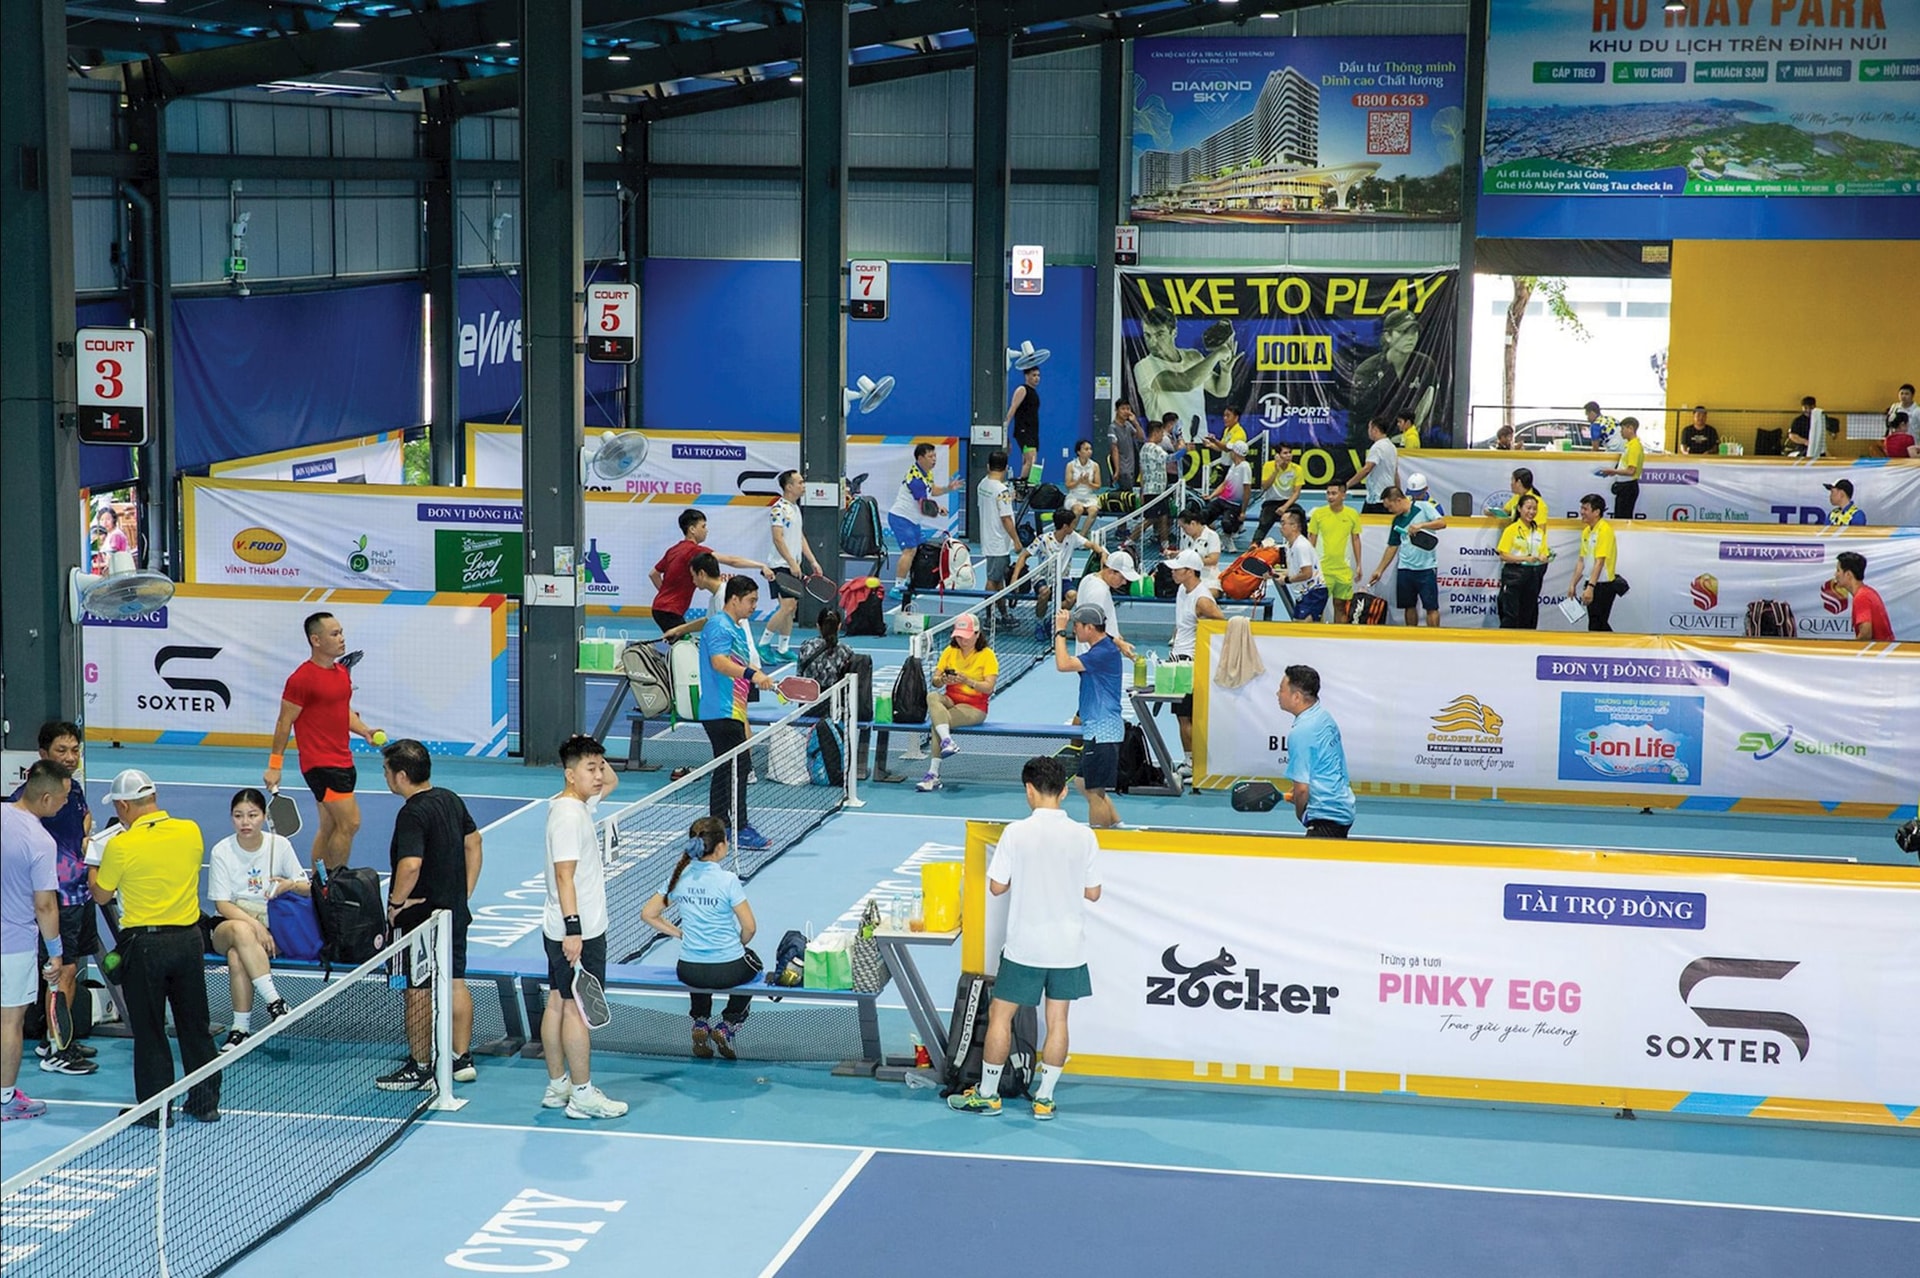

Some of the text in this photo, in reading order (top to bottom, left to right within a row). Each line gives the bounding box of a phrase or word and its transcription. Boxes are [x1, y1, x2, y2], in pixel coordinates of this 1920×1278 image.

[1590, 33, 1887, 55] KHU DU LỊCH TRÊN ĐỈNH NÚI
[1339, 60, 1457, 75] Đầu tư Thông minh
[1552, 66, 1596, 78] CÁP TREO
[1633, 67, 1673, 78] VUI CHƠI
[1711, 65, 1765, 80] KHÁCH SẠN
[1794, 65, 1843, 77] NHÀ HÀNG
[1883, 64, 1900, 78] HỘI
[1172, 81, 1252, 91] DIAMOND
[1353, 76, 1375, 86] cao
[1378, 74, 1406, 86] Chất
[1409, 74, 1444, 88] lượng
[1193, 92, 1229, 102] SKY
[1356, 94, 1424, 106] 1800 6363
[1496, 169, 1507, 178] Ai
[1509, 169, 1519, 178] đi
[1567, 169, 1582, 179] Sài
[1584, 170, 1609, 179] Gòn,
[1496, 181, 1516, 190] Ghé
[1557, 181, 1581, 190] Park
[1582, 181, 1609, 192] Vũng
[1610, 182, 1629, 190] Tàu
[1631, 181, 1661, 190] check
[1663, 182, 1673, 190] in
[1116, 236, 1135, 250] 11
[855, 264, 882, 272] COURT
[1020, 258, 1033, 275] 9
[859, 275, 875, 296] 7
[594, 290, 629, 300] COURT
[1137, 276, 1448, 315] LIKE TO PLAY
[600, 304, 620, 332] 5
[84, 340, 135, 352] COURT
[1260, 341, 1328, 366] JOOLA
[94, 359, 124, 399] 3
[1283, 406, 1331, 417] SPORTS
[676, 446, 742, 458] TÀI TRỢ ĐỒNG
[1646, 472, 1668, 482] TRỢ
[1669, 473, 1690, 483] BẠC
[625, 480, 670, 494] PINKY
[674, 482, 702, 494] EGG
[427, 508, 451, 518] ĐƠN
[454, 509, 466, 520] VỊ
[469, 507, 501, 519] ĐỒNG
[1460, 547, 1499, 556] DoanhN
[1727, 544, 1818, 559] TÀI TRỢ VÀNG
[463, 551, 495, 571] Live
[463, 554, 503, 583] cool
[282, 567, 300, 578] ĐẠT
[1450, 564, 1471, 575] GIẢI
[587, 585, 619, 593] GROUP
[1450, 593, 1486, 603] DOANH
[1450, 605, 1487, 615] TP.HCM
[1669, 614, 1738, 630] QUAVIET
[1799, 617, 1855, 632] QUAVI
[1552, 661, 1713, 680] ĐƠN VỊ ĐỒNG HÀNH
[137, 695, 215, 712] SOXTER
[1269, 736, 1288, 751] BL
[1590, 732, 1676, 758] i-on Life
[1794, 741, 1867, 756] Solution
[1415, 754, 1515, 771] Designed to work for you
[687, 887, 706, 895] TEAM
[1517, 890, 1694, 920] TÀI TRỢ ĐỒNG
[1380, 953, 1442, 968] Trứng gà tươi
[1146, 967, 1340, 1015] zocker
[1379, 973, 1582, 1013] PINKY EGG
[1440, 1014, 1580, 1047] Trao gửi yêu thương
[1645, 1034, 1781, 1064] SOXTER
[444, 1188, 628, 1273] CITY
